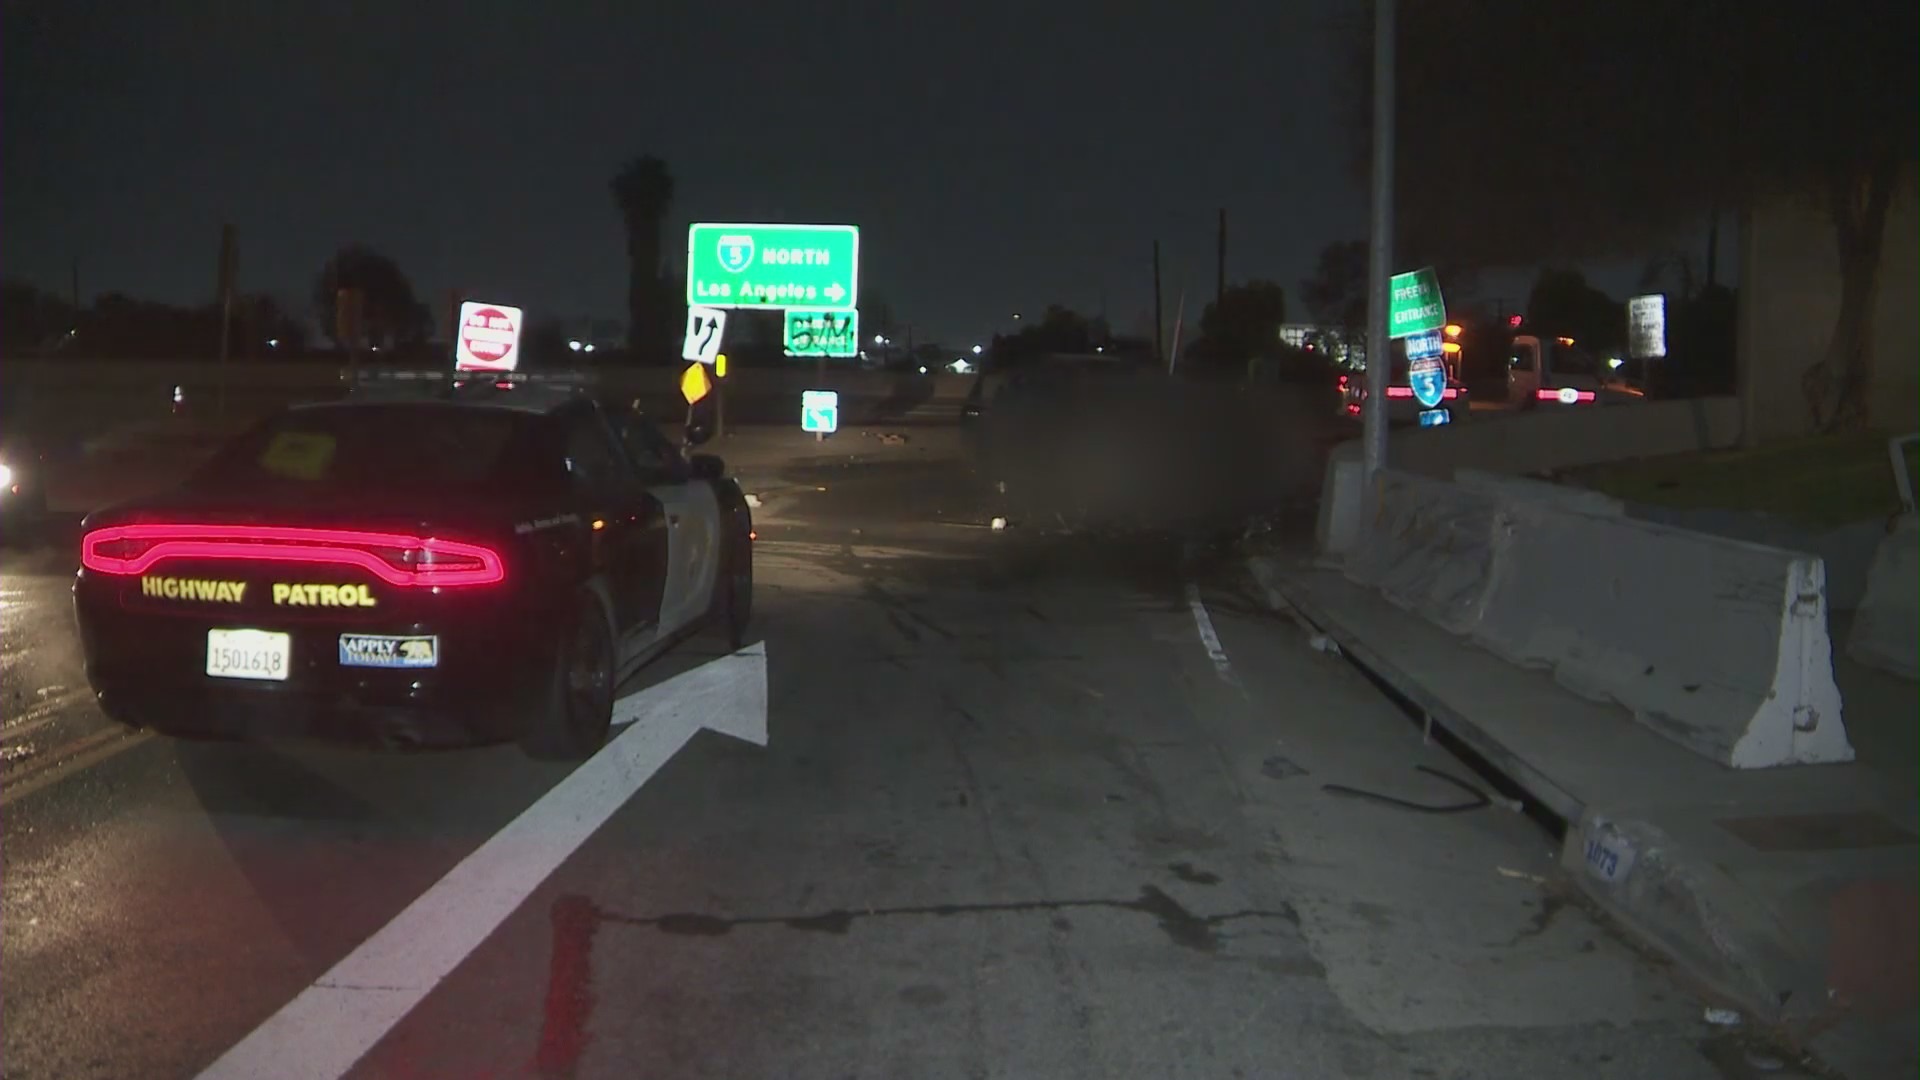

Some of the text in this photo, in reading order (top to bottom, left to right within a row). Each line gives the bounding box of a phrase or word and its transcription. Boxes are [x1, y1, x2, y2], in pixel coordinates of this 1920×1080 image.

[729, 247, 830, 265] 5 NORTH
[697, 280, 817, 301] Los Angeles
[1394, 303, 1439, 325] ENTRANCE
[1407, 336, 1441, 354] NORTH
[1423, 377, 1435, 397] 5
[142, 576, 375, 607] HIGHWAY PATROL
[346, 637, 397, 654] APPLY
[211, 647, 282, 672] 1501618
